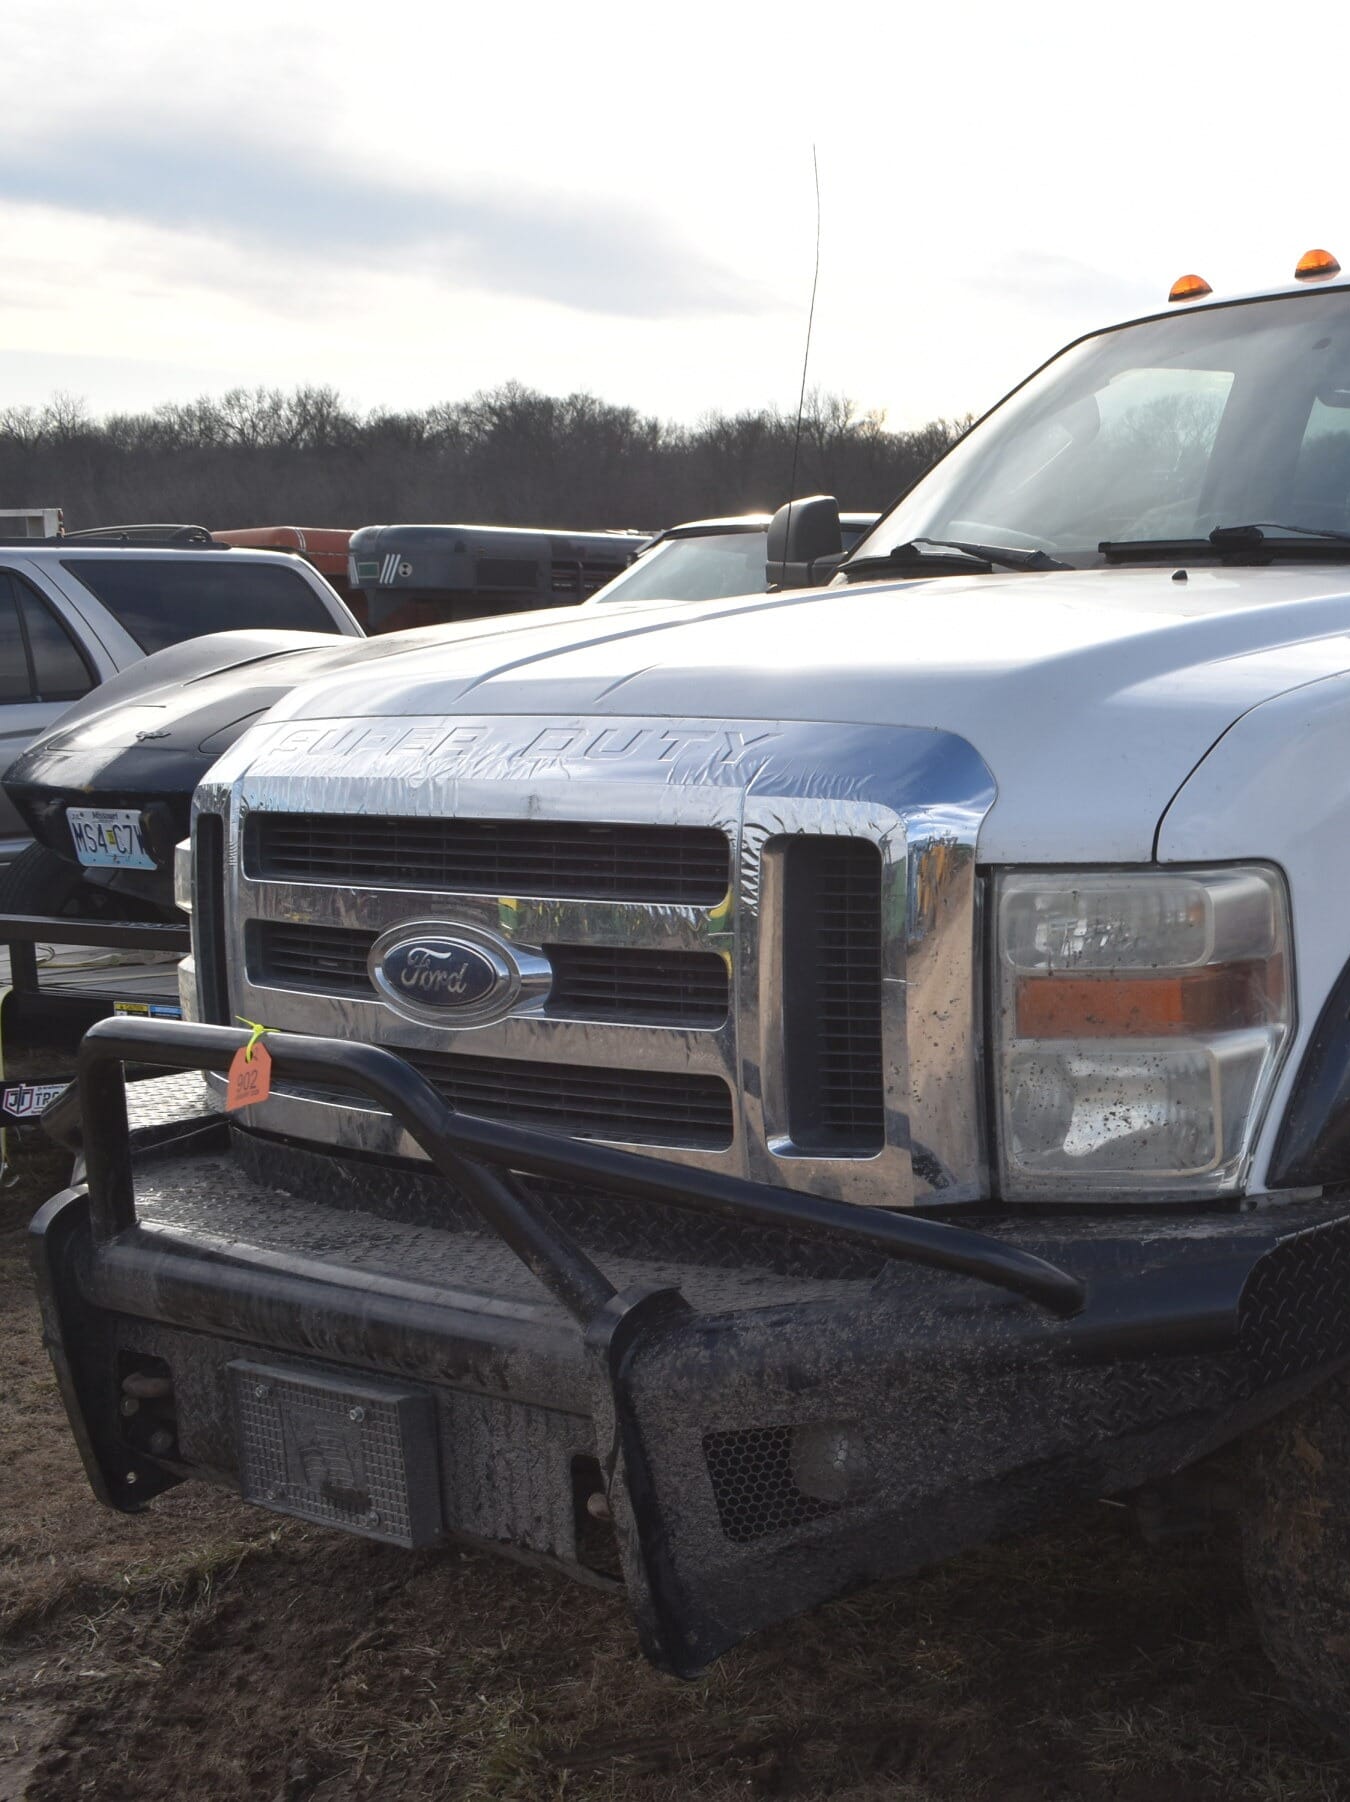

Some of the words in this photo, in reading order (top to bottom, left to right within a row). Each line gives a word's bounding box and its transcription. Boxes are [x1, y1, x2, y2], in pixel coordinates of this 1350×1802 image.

[268, 725, 495, 757] SUPER
[518, 727, 784, 765] DUTY
[71, 822, 109, 854] MS4
[401, 947, 469, 994] Ford
[237, 1069, 258, 1091] 902
